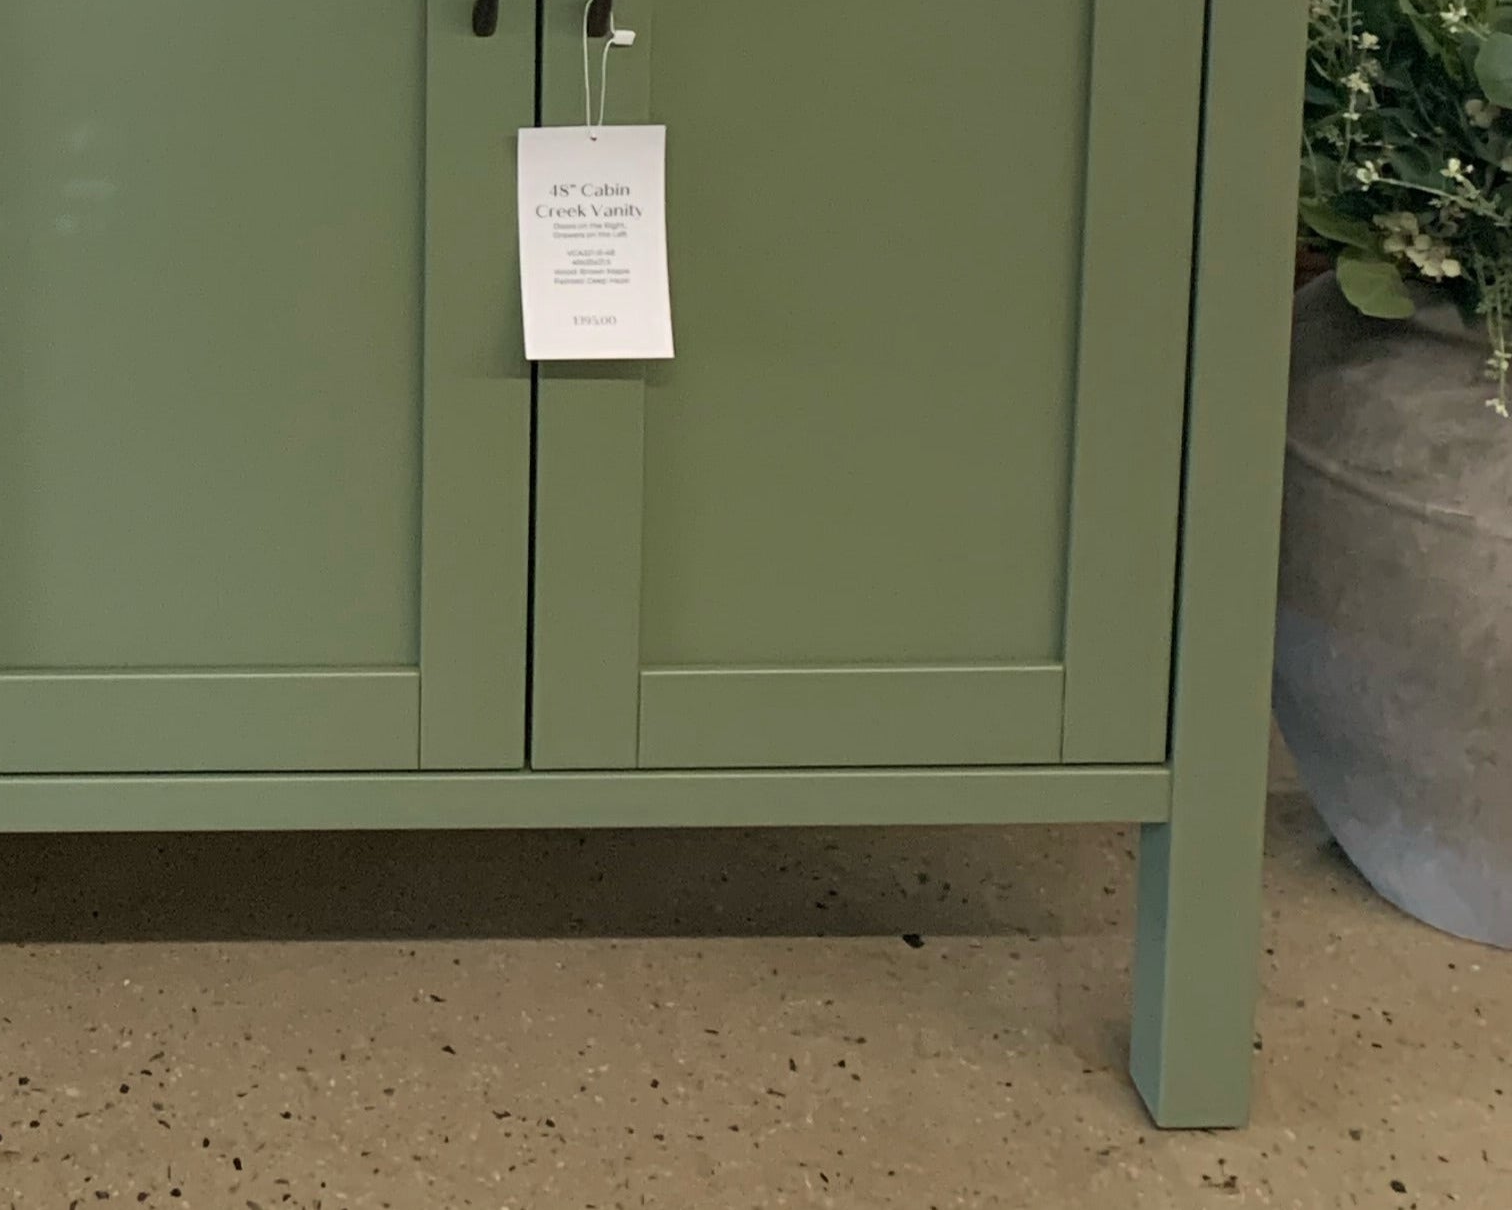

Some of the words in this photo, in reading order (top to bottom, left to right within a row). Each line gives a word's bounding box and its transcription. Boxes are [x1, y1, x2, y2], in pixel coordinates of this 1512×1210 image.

[580, 182, 631, 198] Cabin
[535, 203, 587, 219] Creek
[590, 202, 644, 219] Vanity
